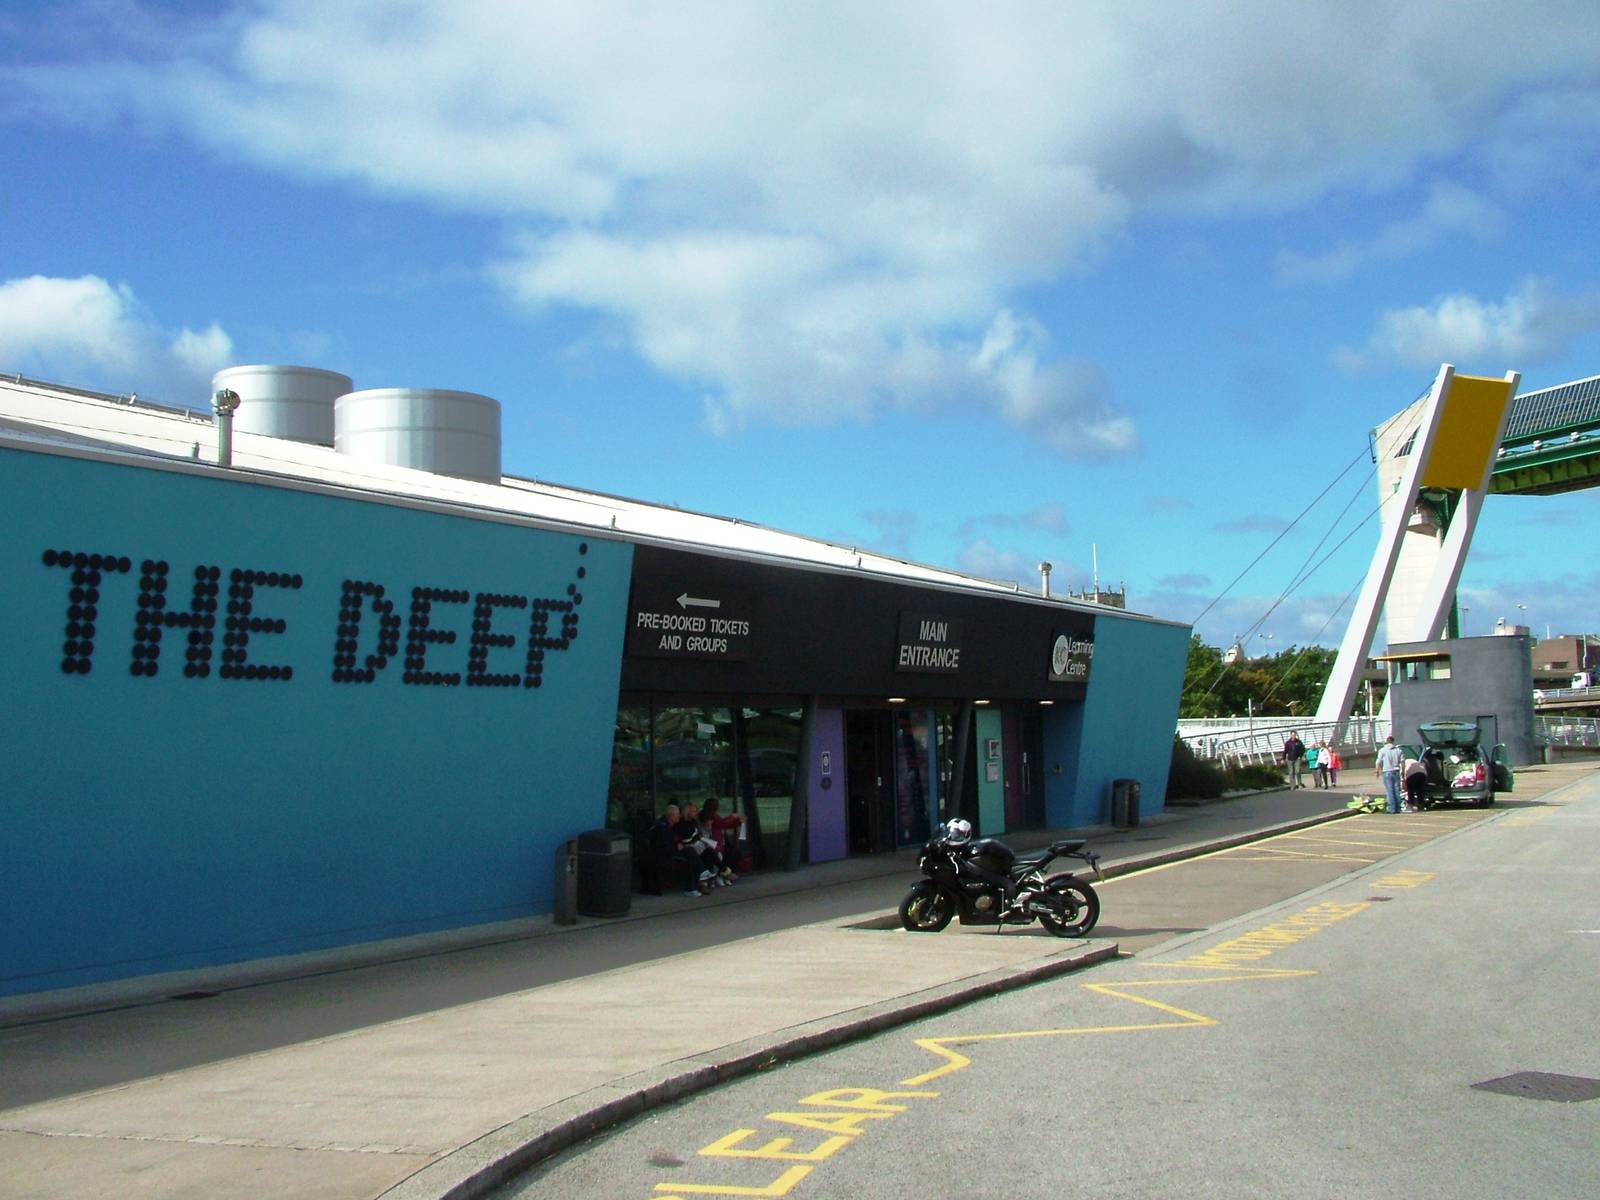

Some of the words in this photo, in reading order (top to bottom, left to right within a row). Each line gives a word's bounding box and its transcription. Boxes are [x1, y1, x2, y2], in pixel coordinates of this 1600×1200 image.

[42, 548, 303, 681] THE
[331, 579, 580, 688] DEEP
[637, 612, 706, 632] PRE-BOOKED
[710, 619, 750, 635] TICKETS
[919, 620, 948, 642] MAIN
[659, 634, 682, 650] AND
[686, 636, 728, 653] GROUPS
[898, 645, 961, 668] ENTRANCE
[1066, 658, 1087, 676] Centre
[647, 1087, 942, 1200] LEAR
